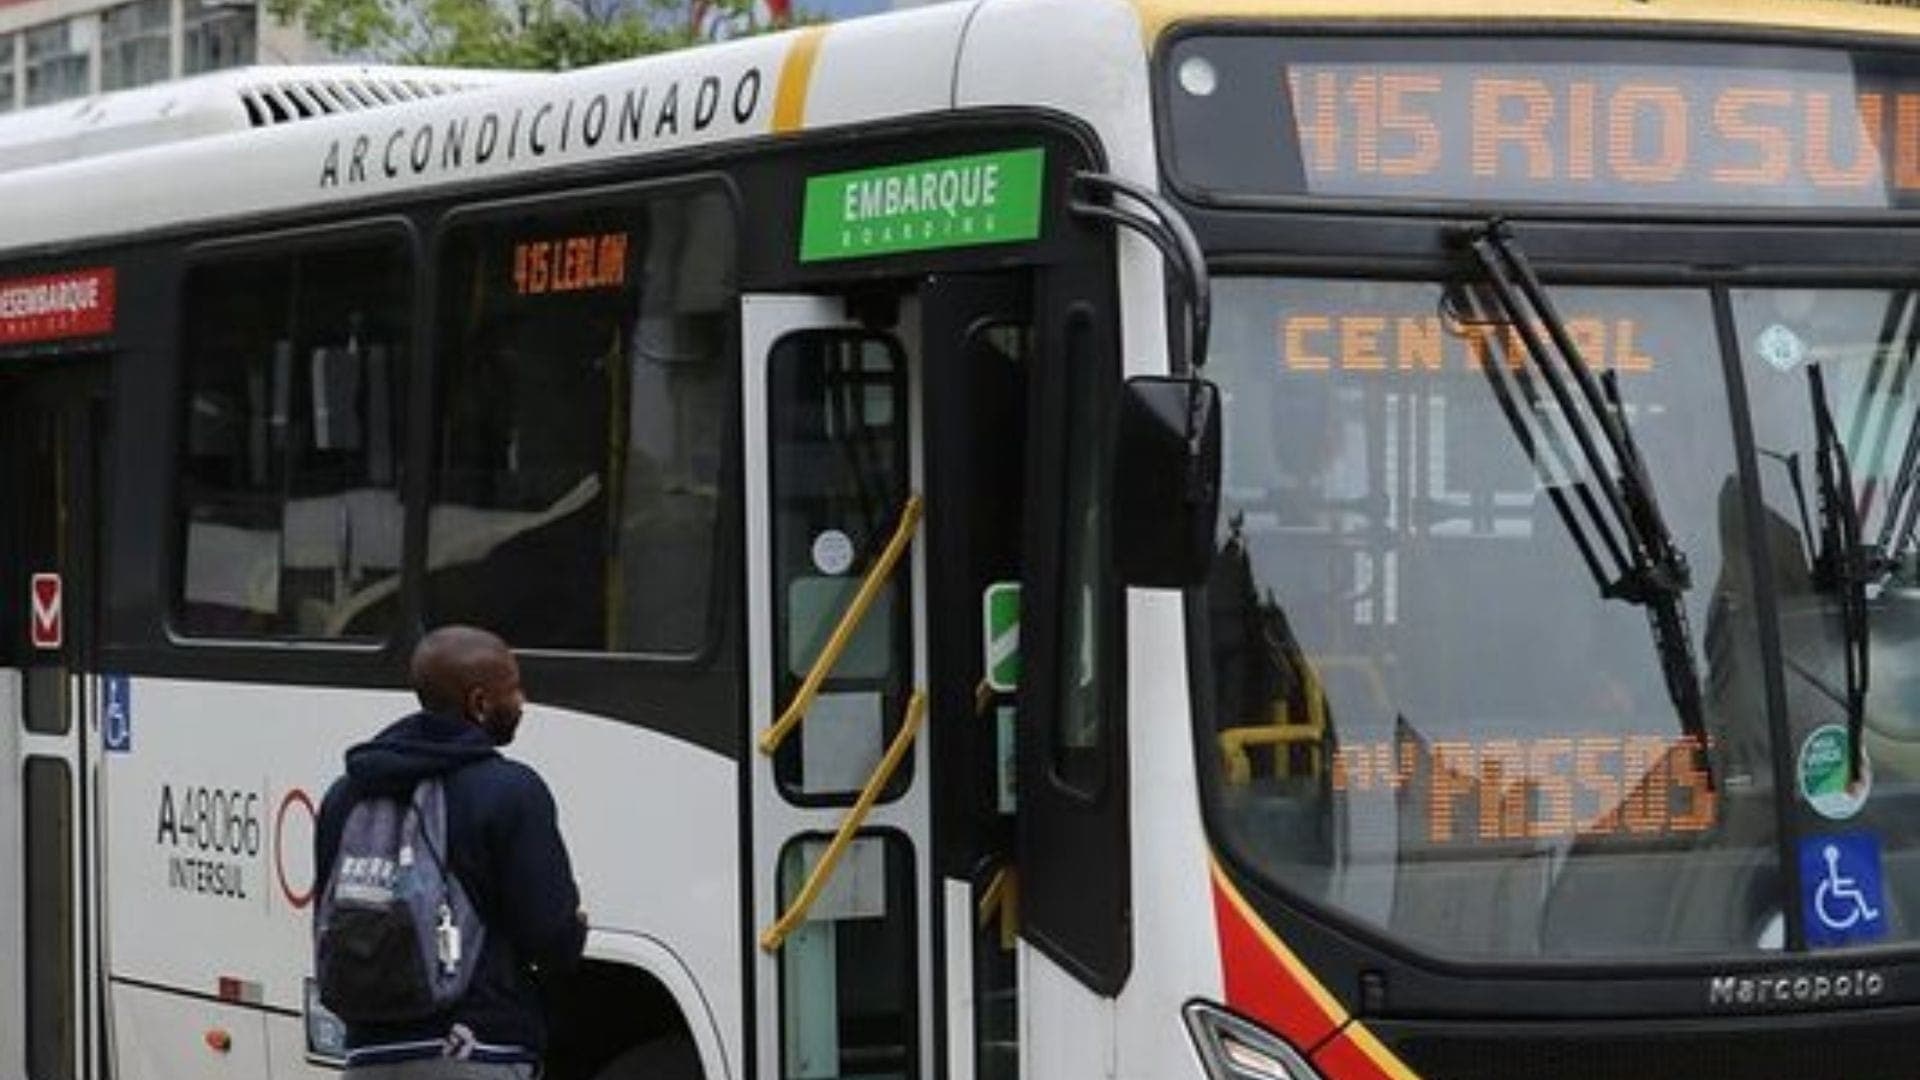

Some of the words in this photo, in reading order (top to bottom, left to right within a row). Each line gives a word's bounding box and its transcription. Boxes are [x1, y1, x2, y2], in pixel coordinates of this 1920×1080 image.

[383, 68, 762, 178] CONDICIONADO
[1470, 78, 1689, 183] RIO
[844, 165, 999, 221] EMBARQUE
[157, 784, 259, 857] A48066
[1430, 735, 1718, 842] PASSOS
[169, 858, 246, 899] INTERSUL
[1711, 970, 1883, 1003] Marcopolo
